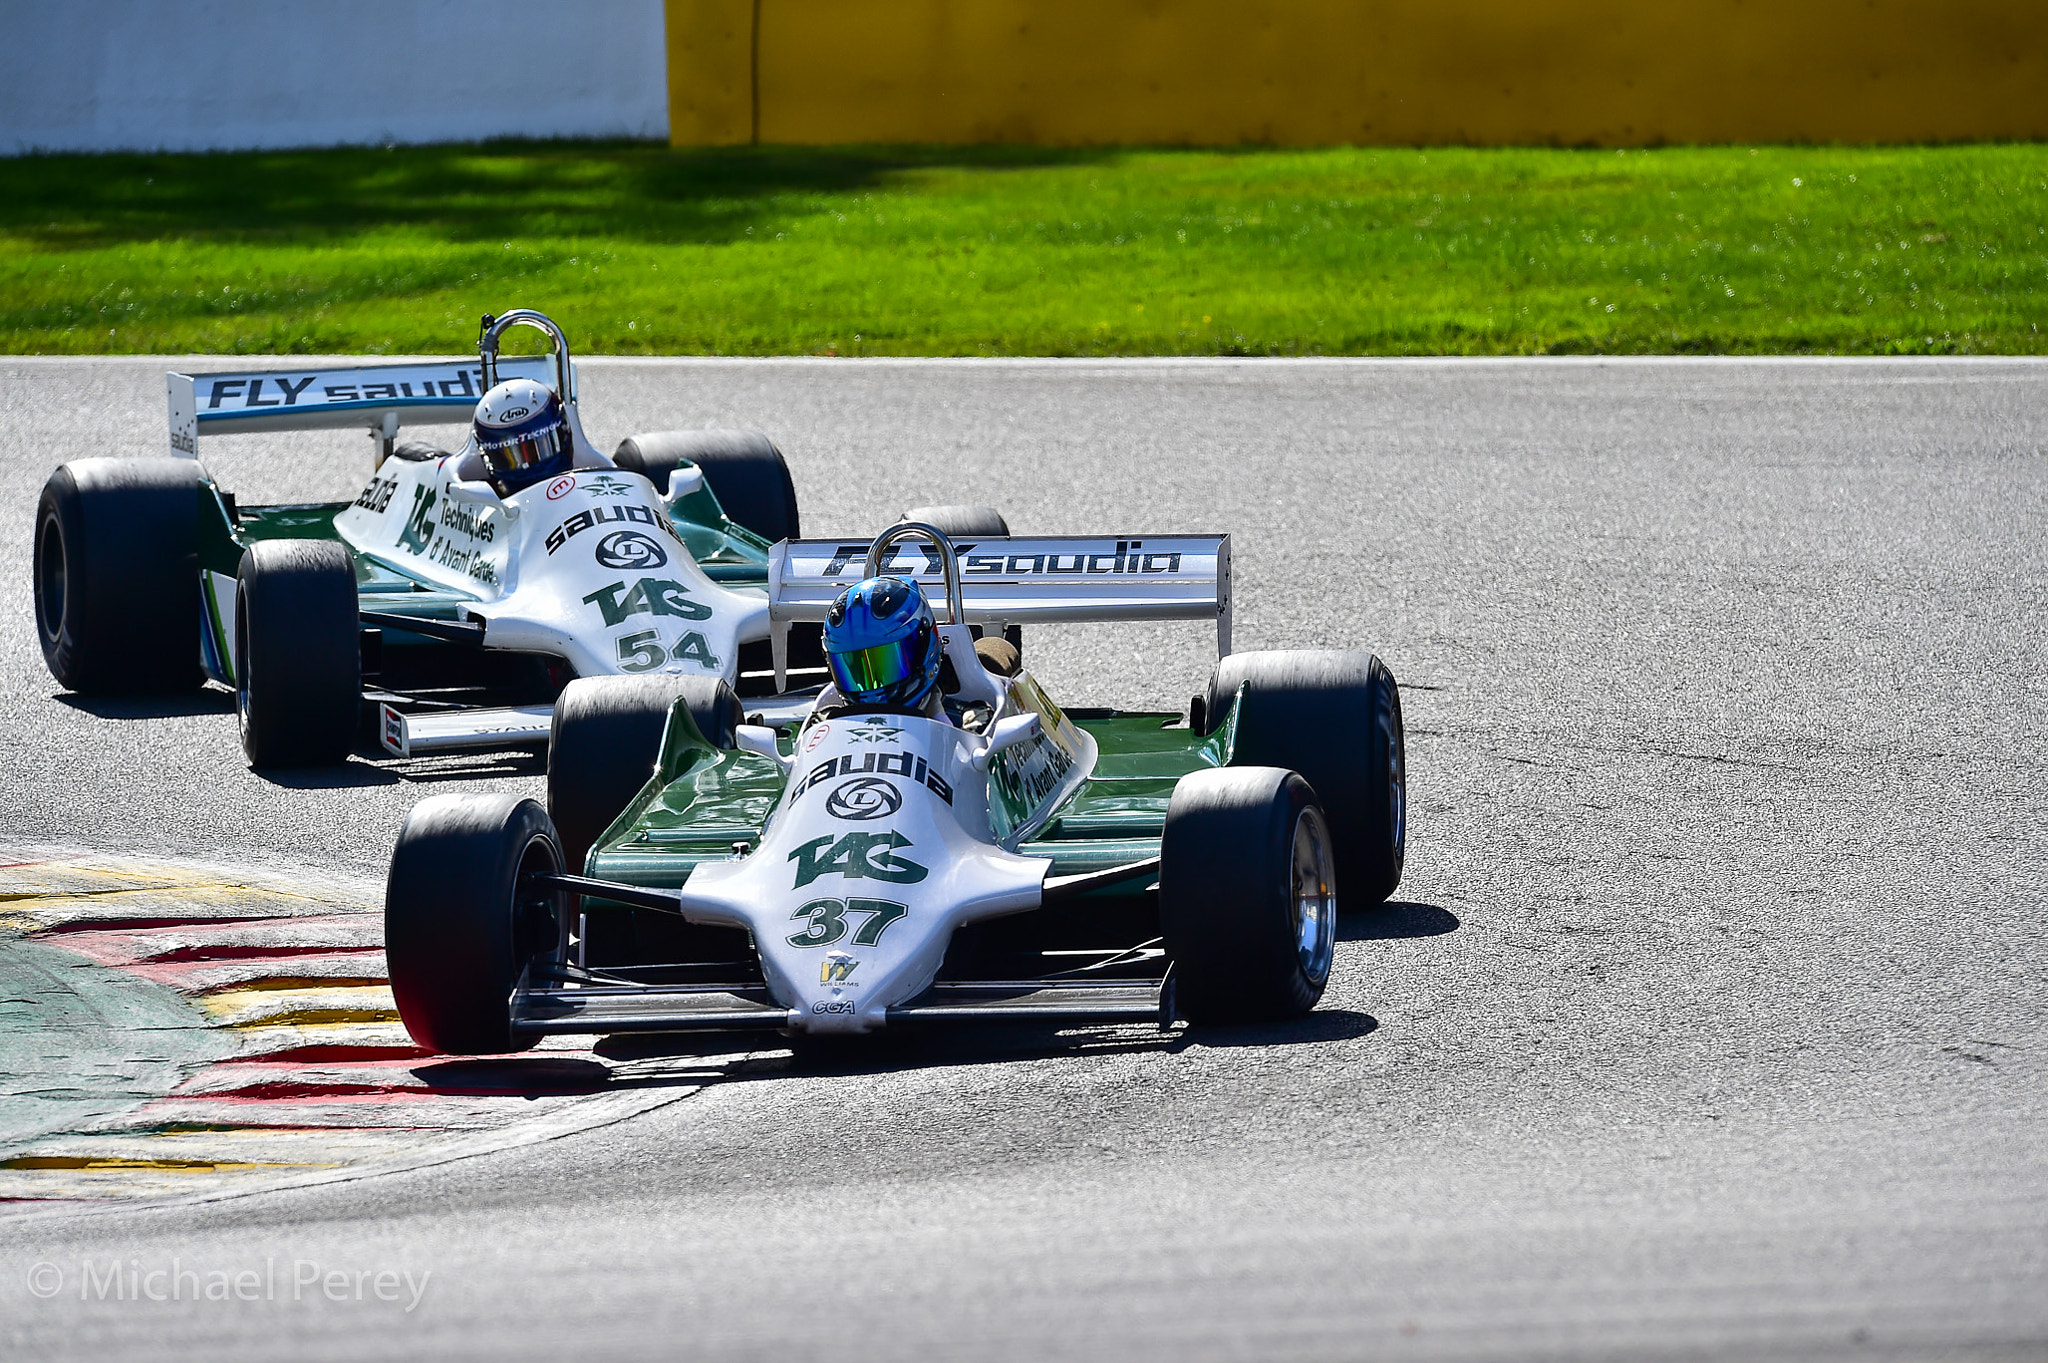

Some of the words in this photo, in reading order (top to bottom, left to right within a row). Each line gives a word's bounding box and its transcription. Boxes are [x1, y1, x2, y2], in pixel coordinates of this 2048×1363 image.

[208, 377, 316, 408] FLY
[545, 505, 686, 556] saudia
[438, 540, 471, 574] Avant
[965, 541, 1183, 574] saudia
[582, 577, 712, 628] TAG
[615, 628, 723, 673] 54
[788, 751, 953, 810] saudia
[787, 829, 929, 890] TAG
[785, 897, 909, 949] 37
[812, 1000, 855, 1015] CGA
